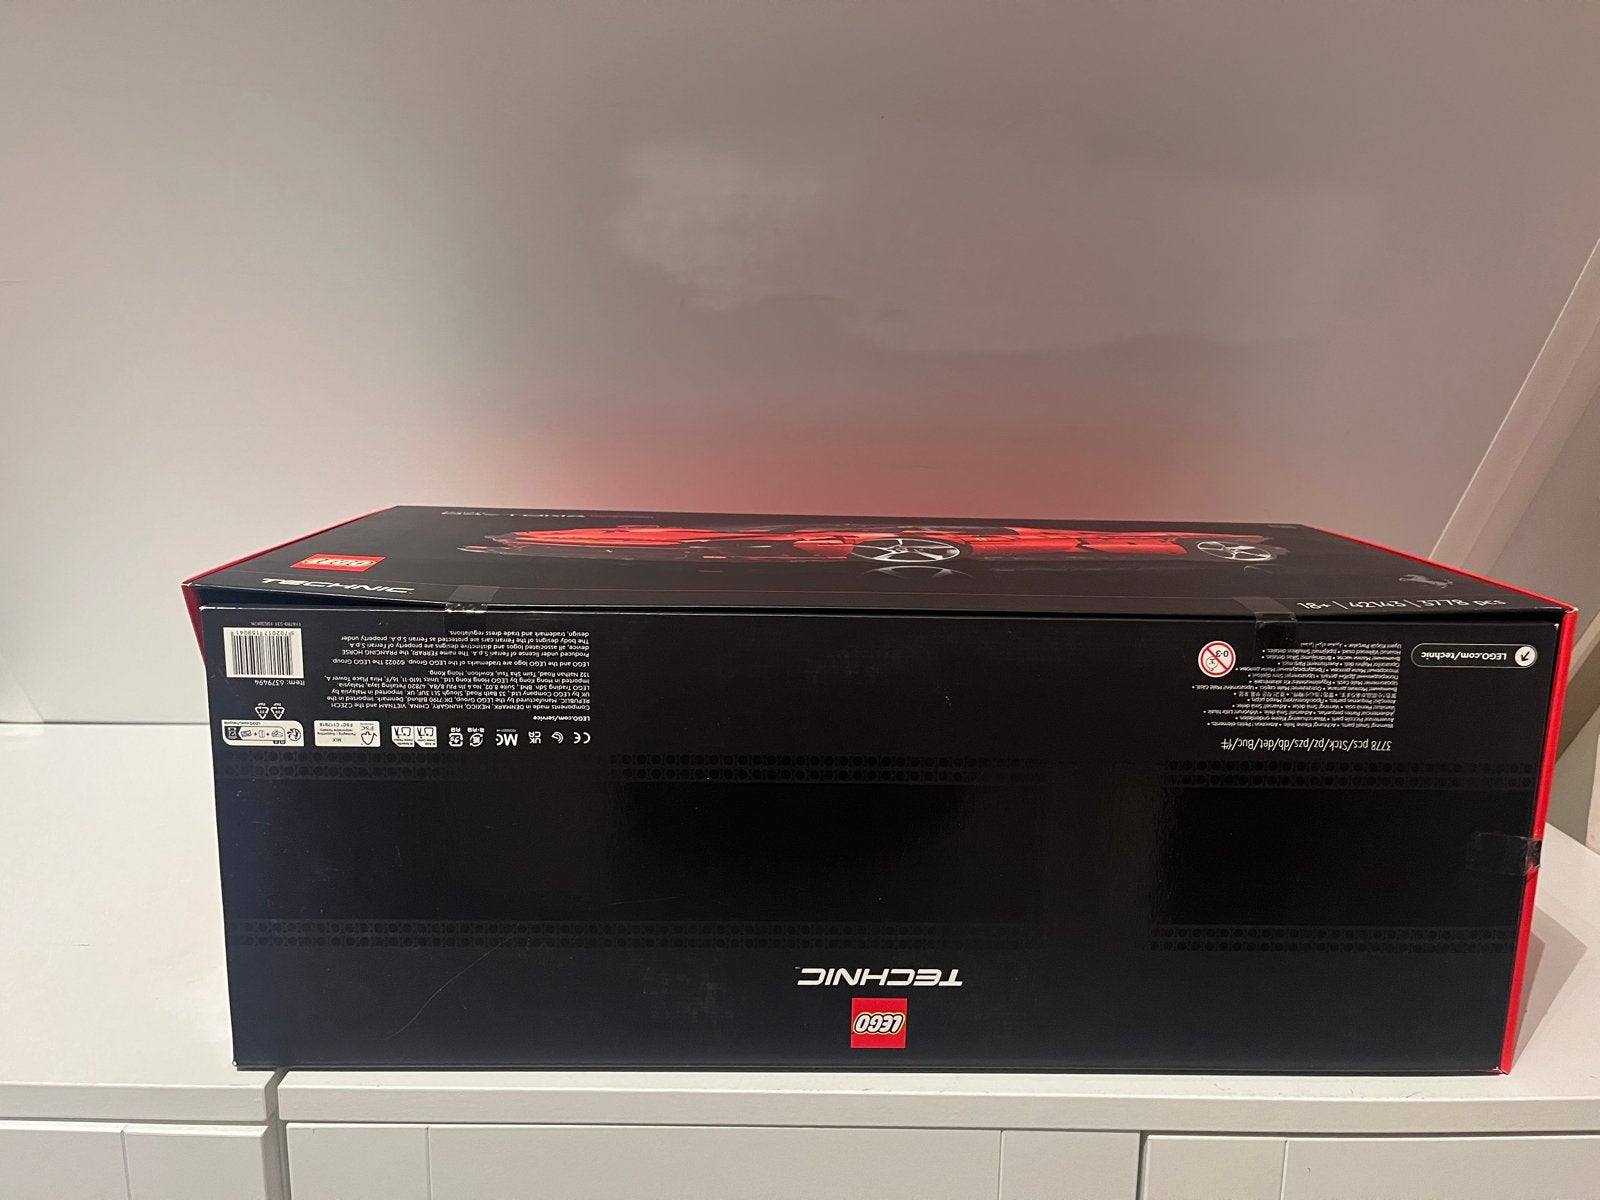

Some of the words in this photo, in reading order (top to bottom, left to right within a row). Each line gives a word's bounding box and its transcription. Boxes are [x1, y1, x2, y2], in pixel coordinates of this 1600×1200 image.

[262, 578, 414, 593] TECHNIC
[1350, 600, 1406, 608] 42143
[1416, 599, 1470, 607] 3778
[1421, 652, 1506, 660] LEGO.com/technic
[1371, 740, 1392, 751] 3778
[797, 968, 963, 986] TECHNIC
[854, 1013, 904, 1034] LEGO
